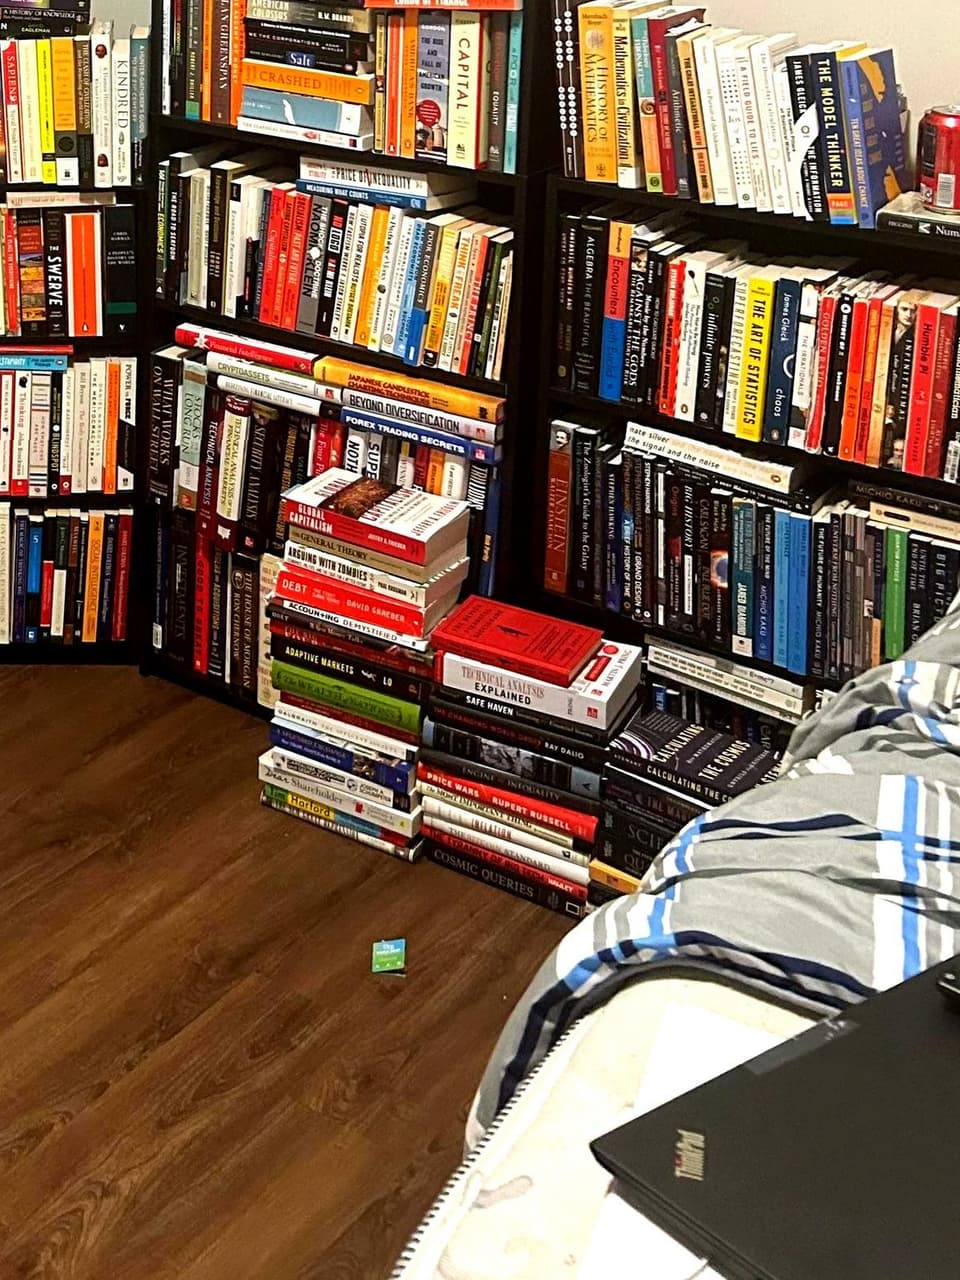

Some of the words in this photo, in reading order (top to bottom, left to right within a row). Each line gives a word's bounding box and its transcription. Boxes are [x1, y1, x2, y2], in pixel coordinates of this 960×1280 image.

[290, 52, 311, 66] Salt
[614, 35, 627, 100] Mathematics
[793, 61, 805, 85] JAMES
[817, 59, 829, 85] THE
[260, 70, 322, 89] CRASHED
[457, 38, 470, 111] CAPITAL
[117, 60, 129, 129] KINDRED
[796, 88, 807, 114] GLEICK
[821, 88, 836, 129] MODEL
[672, 89, 683, 134] Arithmetic
[827, 134, 844, 188] THINKER
[809, 161, 823, 213] INFORMATION
[584, 236, 595, 280] ALGEBRA
[48, 255, 63, 306] SWERVE
[755, 299, 766, 319] THE
[752, 322, 762, 345] ART
[752, 346, 761, 362] OF
[217, 362, 271, 383] CRYPTOASSETS
[745, 363, 761, 426] STATISTICS
[774, 387, 783, 417] chaos
[350, 395, 384, 413] BEYOND
[385, 403, 460, 433] DIVERSIFICATION
[346, 416, 376, 430] FOREX
[378, 423, 418, 440] TRADING
[421, 436, 465, 454] SECRETS
[630, 426, 647, 437] nate
[648, 431, 670, 444] silver
[628, 437, 641, 448] the
[642, 439, 665, 453] signal
[667, 446, 682, 458] and
[683, 451, 697, 462] the
[698, 458, 720, 469] noise
[290, 512, 333, 534] CAPITALISM
[298, 504, 325, 519] GLOBAL
[288, 547, 317, 564] ARGUING
[319, 555, 336, 570] WITH
[338, 559, 368, 581] ZOMBIES
[282, 580, 307, 593] DEBT
[286, 646, 319, 664] ADAPTIVE
[322, 658, 354, 675] MARKETS
[466, 695, 486, 707] SAFE
[488, 702, 513, 716] HAVEN
[475, 683, 531, 705] EXPLAINED
[545, 742, 558, 752] RAY
[561, 746, 584, 760] DALIO
[427, 773, 453, 788] PRICE
[455, 783, 479, 797] WARS
[647, 765, 701, 793] CALCULATING
[704, 787, 719, 800] THE
[291, 795, 331, 817] Harford
[492, 797, 527, 814] RUPERT
[530, 810, 571, 831] RUSSELL
[434, 849, 478, 875] COSMIC
[482, 866, 534, 897] QUERIES
[675, 1128, 705, 1181] ThinkPad
